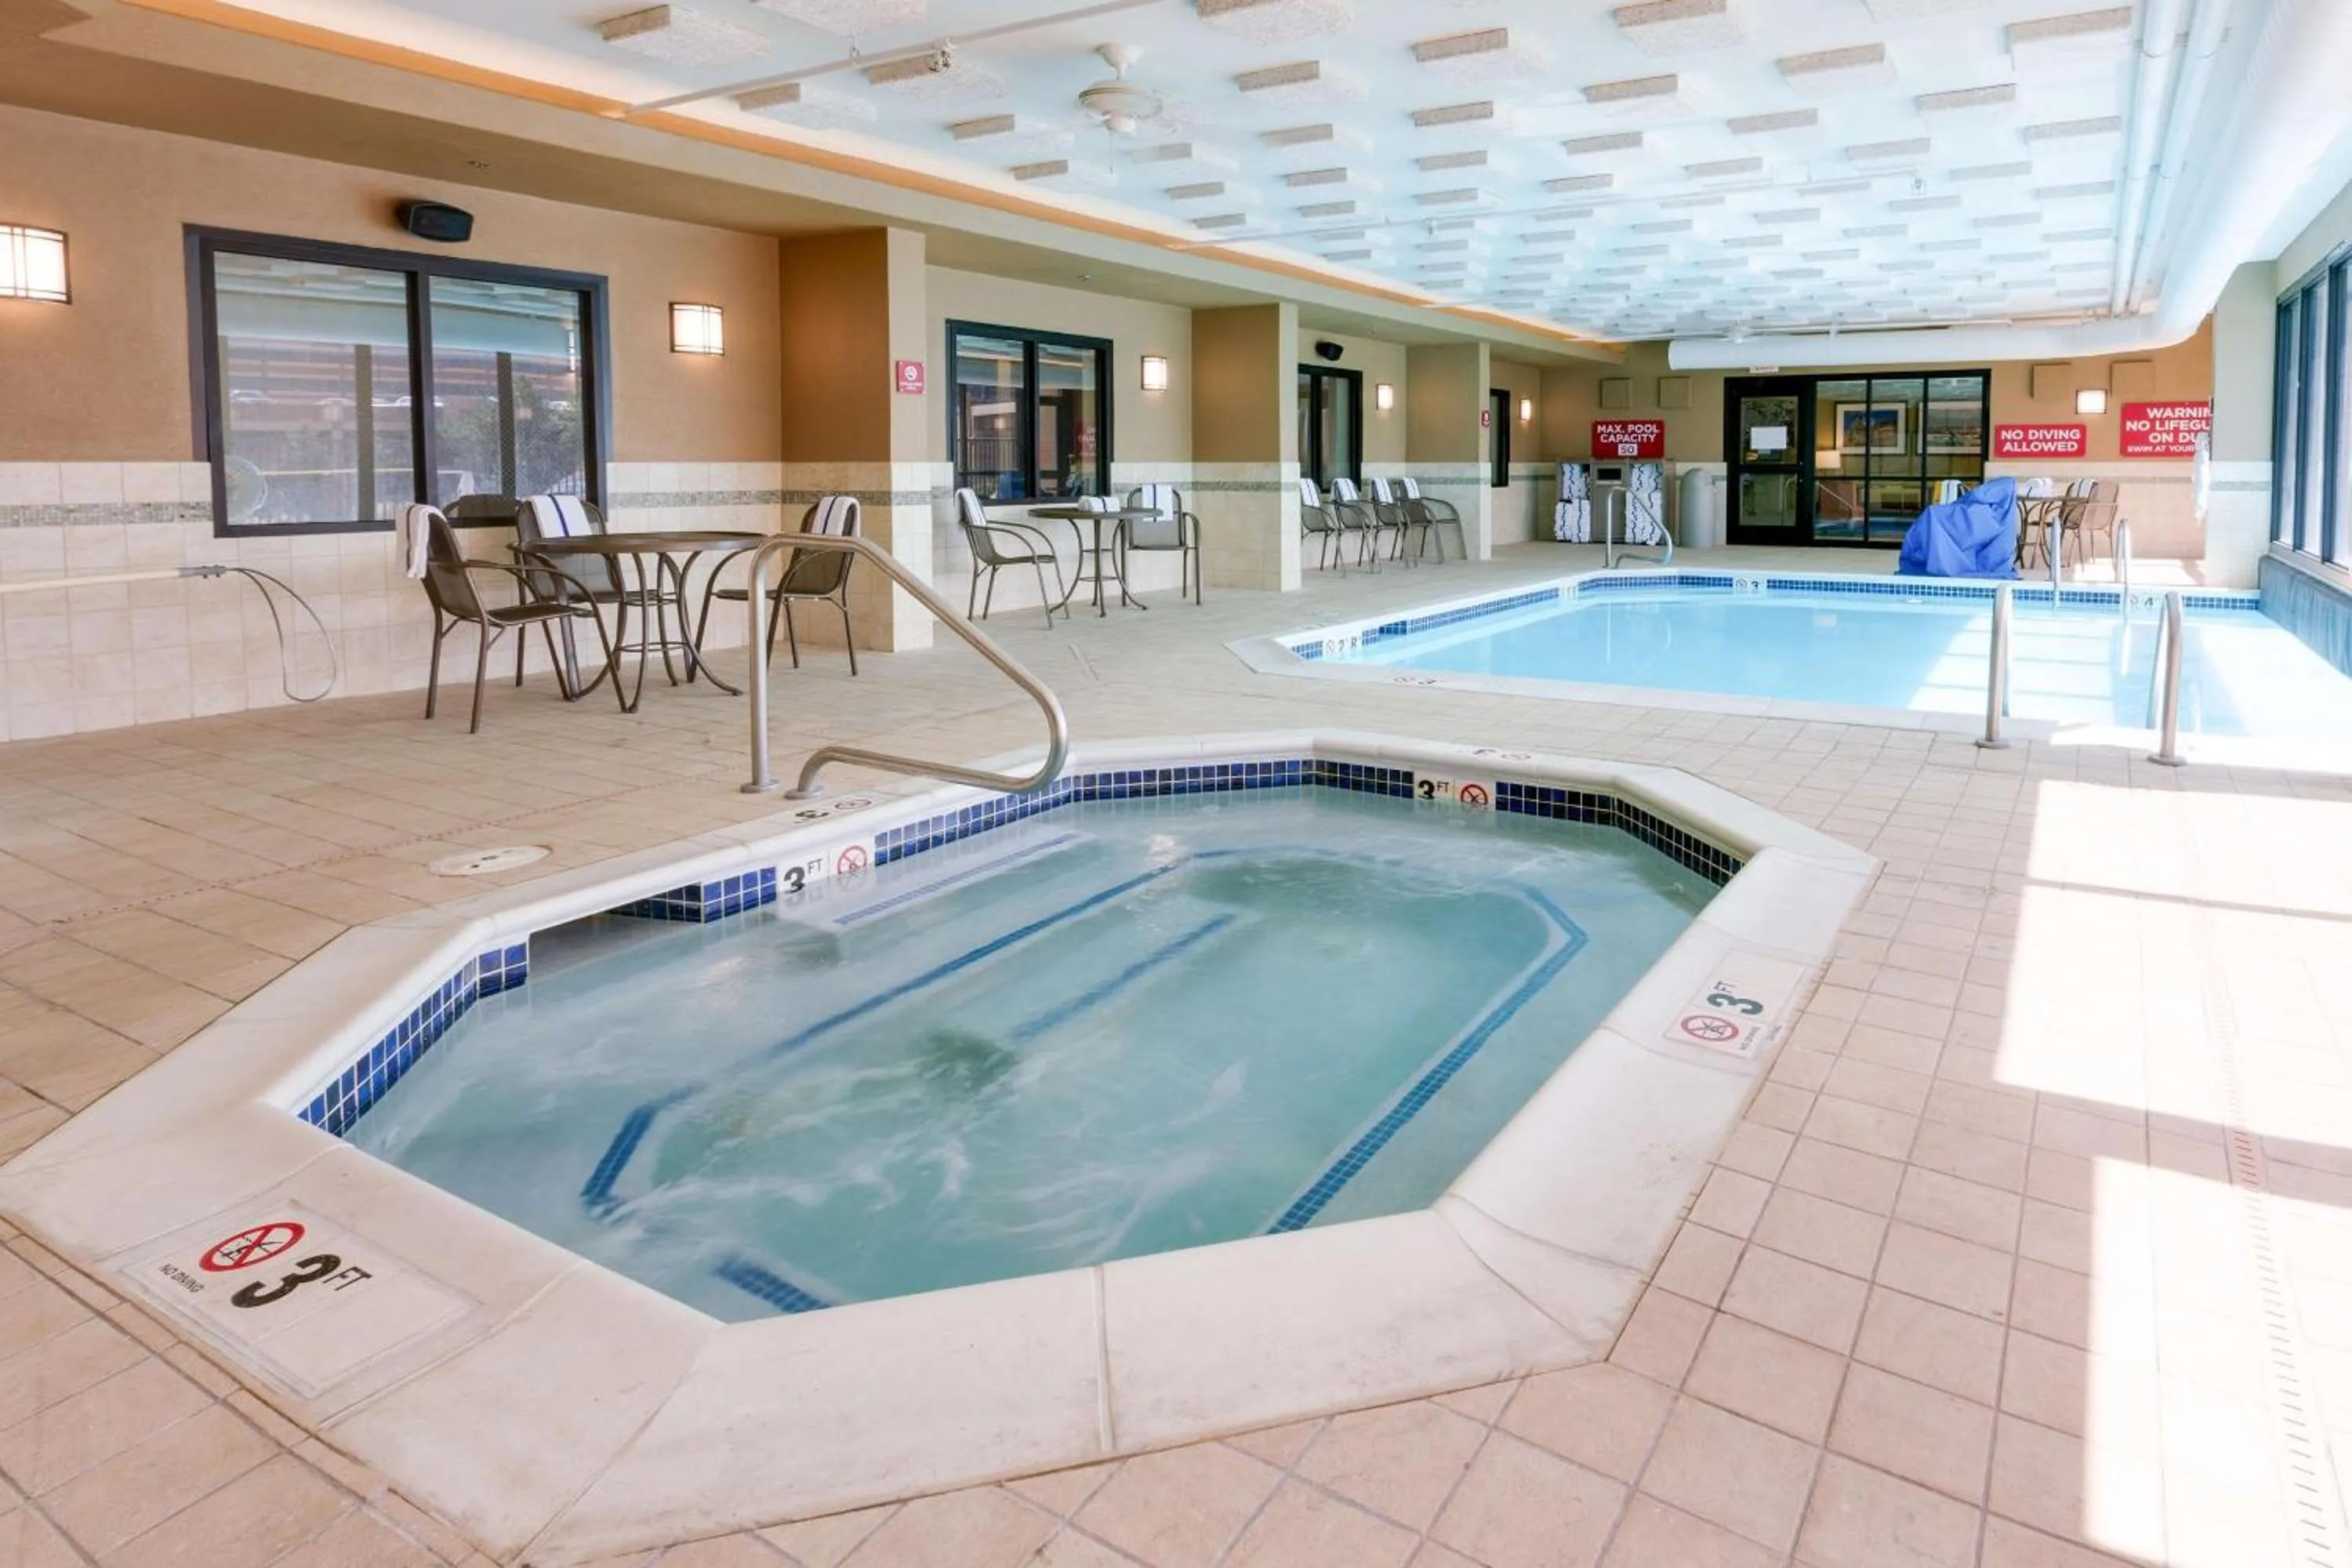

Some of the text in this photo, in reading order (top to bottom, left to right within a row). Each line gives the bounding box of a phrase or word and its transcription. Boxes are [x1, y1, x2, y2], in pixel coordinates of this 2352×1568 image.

[1597, 424, 1660, 434] MAX. POOL
[2125, 421, 2150, 431] NO
[1600, 434, 1657, 443] CAPACITY
[2002, 429, 2082, 440] NO DIVING
[2148, 433, 2173, 443] ON
[1621, 445, 1635, 454] 50
[2003, 441, 2078, 452] ALLOWED
[1418, 780, 1450, 800] 3 FT
[784, 858, 822, 894] 3 FT
[1713, 981, 1737, 993] FT
[1707, 993, 1763, 1014] 3
[230, 1254, 372, 1308] 3 FT
